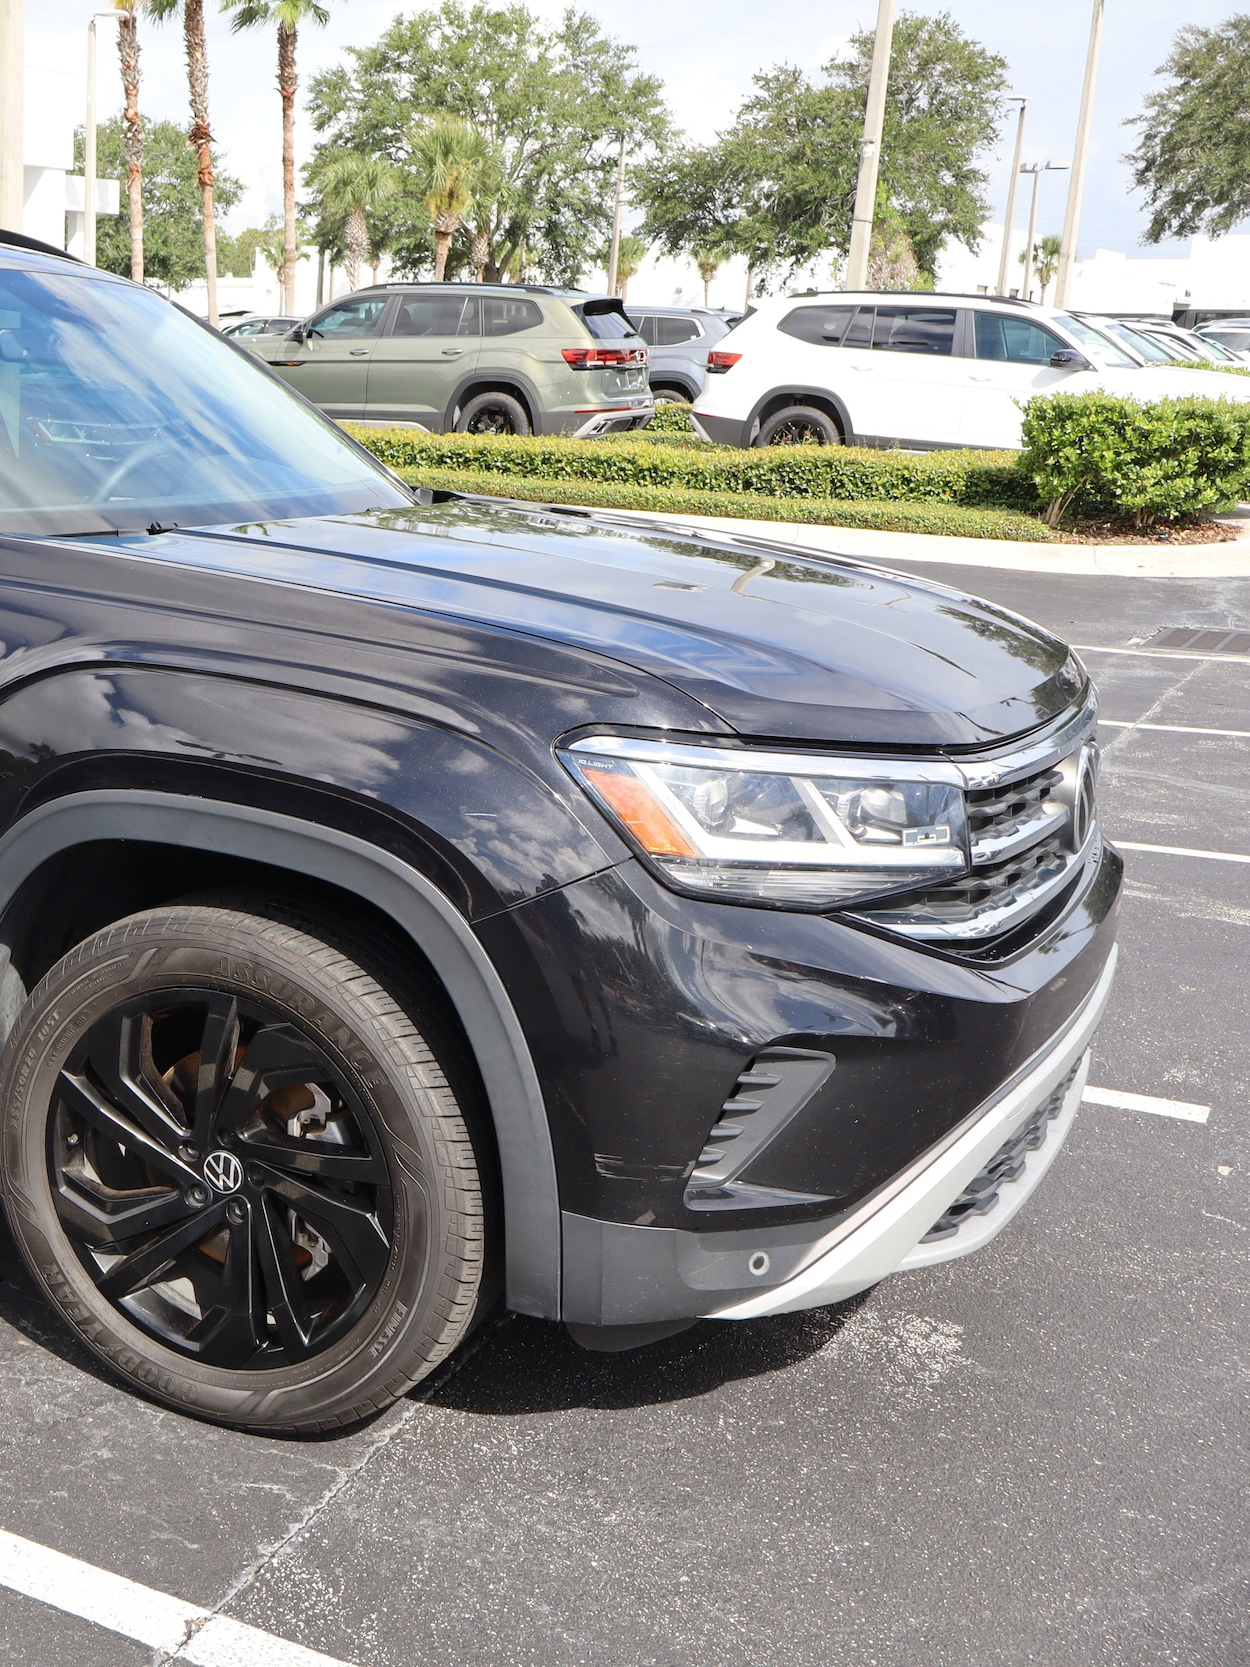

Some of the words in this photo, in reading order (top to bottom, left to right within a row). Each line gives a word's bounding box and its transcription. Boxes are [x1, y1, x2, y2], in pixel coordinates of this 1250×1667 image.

[10, 1047, 37, 1129] 255/50R20
[37, 1009, 62, 1043] 105T
[210, 956, 388, 1089] ASSURANCE
[204, 1152, 242, 1194] VW
[41, 1263, 199, 1403] GOODYEAR
[368, 1300, 409, 1360] FINESSE
